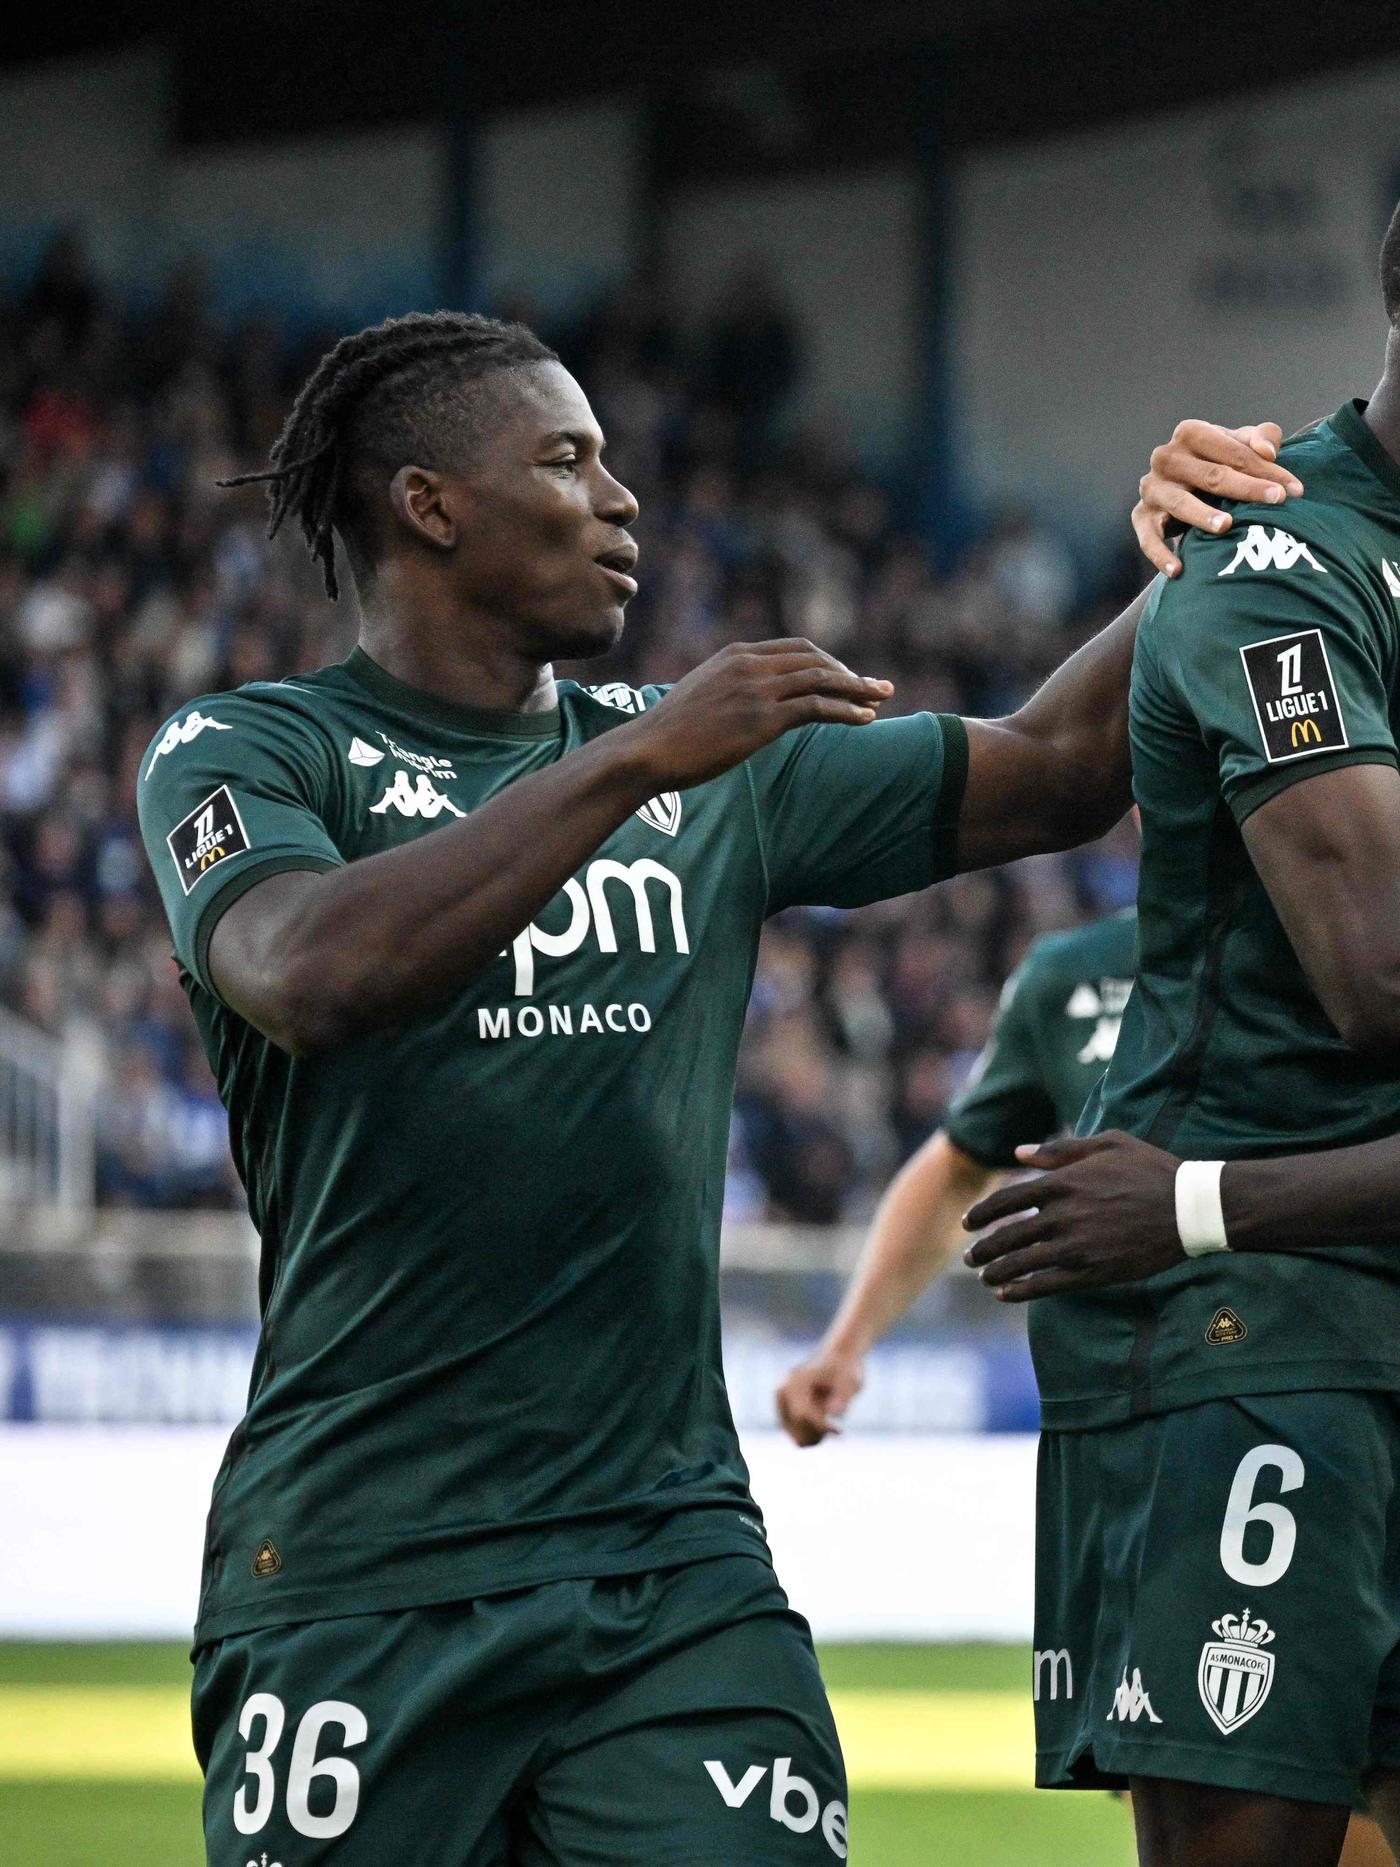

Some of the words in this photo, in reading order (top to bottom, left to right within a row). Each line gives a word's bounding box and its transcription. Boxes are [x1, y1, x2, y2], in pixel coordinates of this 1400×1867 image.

[1265, 692, 1319, 722] LIGUE
[1317, 690, 1329, 711] 1
[184, 829, 226, 869] LIGUE
[224, 823, 234, 836] 1
[498, 857, 691, 997] pm
[477, 1003, 652, 1039] MONACO
[1219, 1443, 1306, 1588] 6
[232, 1691, 370, 1840] 36
